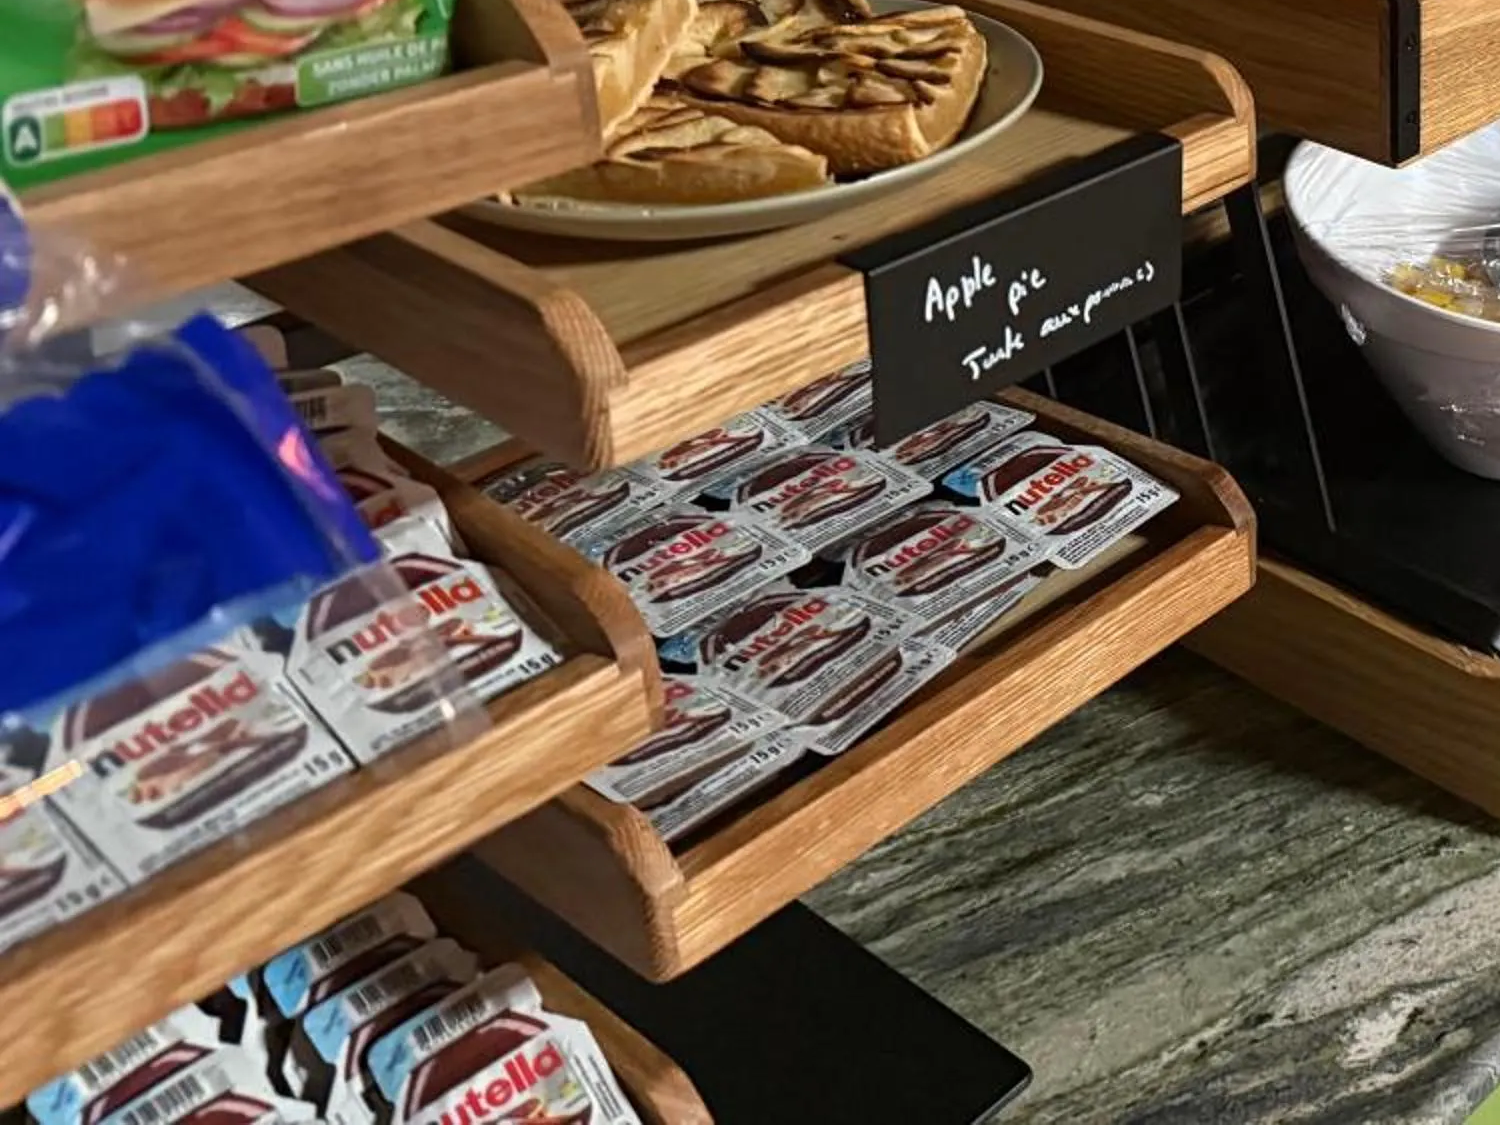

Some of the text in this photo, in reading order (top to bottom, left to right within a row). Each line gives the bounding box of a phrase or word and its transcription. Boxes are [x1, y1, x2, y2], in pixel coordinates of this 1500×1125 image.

[924, 256, 1047, 322] Apple pie
[751, 456, 857, 513] nutella
[1004, 453, 1095, 516] nutella
[617, 523, 730, 583] nutella
[865, 517, 976, 578] nutella
[325, 576, 485, 665] nutella
[724, 595, 830, 672] nutella
[88, 670, 258, 780] nutella
[428, 1040, 564, 1125] utella
